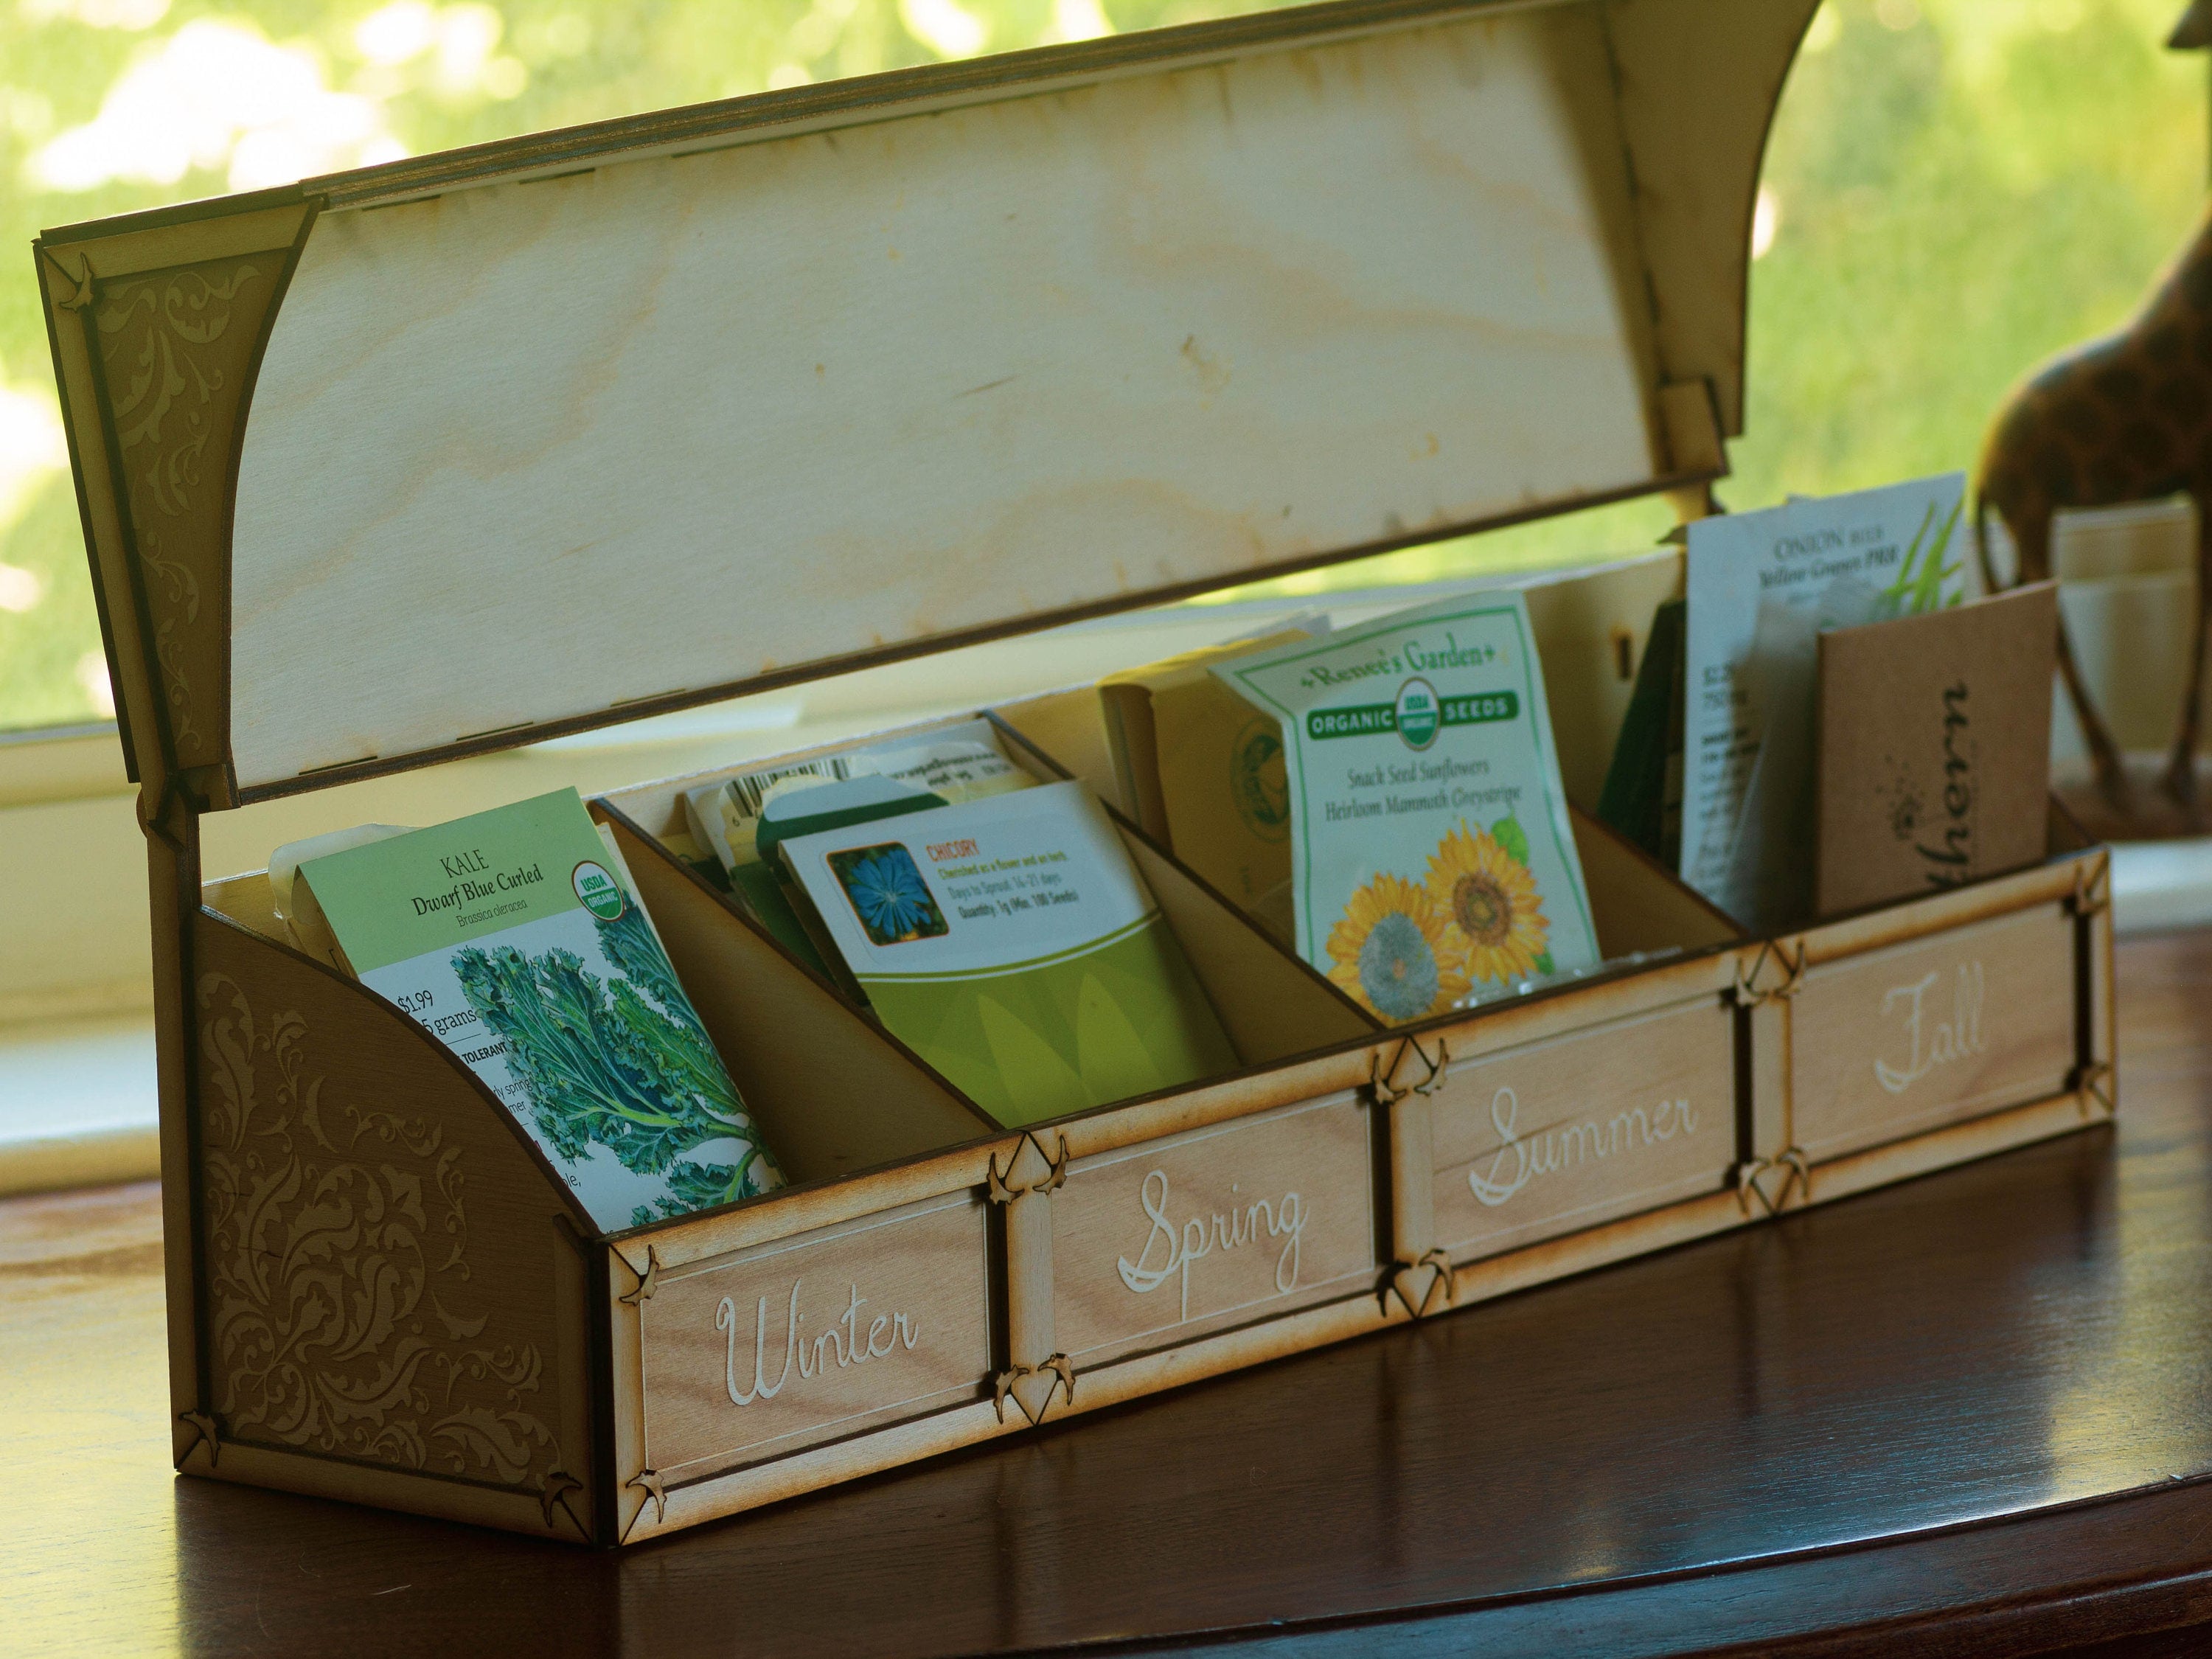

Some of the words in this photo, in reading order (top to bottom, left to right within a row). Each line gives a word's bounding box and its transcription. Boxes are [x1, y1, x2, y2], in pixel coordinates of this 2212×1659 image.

[1773, 528, 1843, 563] ONION
[1403, 632, 1484, 672] Garden
[1311, 710, 1393, 734] ORGANIC
[1444, 697, 1508, 720] SEEDS
[1347, 765, 1385, 789] Snack
[1388, 760, 1417, 785] Seed
[1418, 756, 1490, 785] Sunflowers
[1325, 798, 1382, 821] Heirloom
[1385, 789, 1447, 814] Mammoth
[439, 849, 490, 878] KALE
[926, 838, 980, 863] CHICORY
[938, 863, 979, 880] Cherished
[995, 858, 1020, 870] flower
[1022, 854, 1037, 866] and
[1037, 855, 1047, 864] an
[411, 885, 462, 916] Dwarf
[460, 878, 496, 902] Blue
[496, 863, 544, 891] Curled
[580, 874, 607, 892] USDA
[947, 886, 971, 901] Days
[970, 885, 981, 895] to
[456, 911, 493, 928] Brassica
[493, 899, 528, 918] oleracea
[587, 891, 618, 908] ORGANIC
[397, 990, 434, 1015] $1.99
[434, 1009, 477, 1036] grams
[1874, 960, 1986, 1095] Fall
[462, 1041, 508, 1065] TOLERANT
[505, 1079, 533, 1097] spring
[1468, 1085, 1700, 1208] Summer
[1117, 1169, 1310, 1322] Spring
[715, 1277, 919, 1407] Winter
